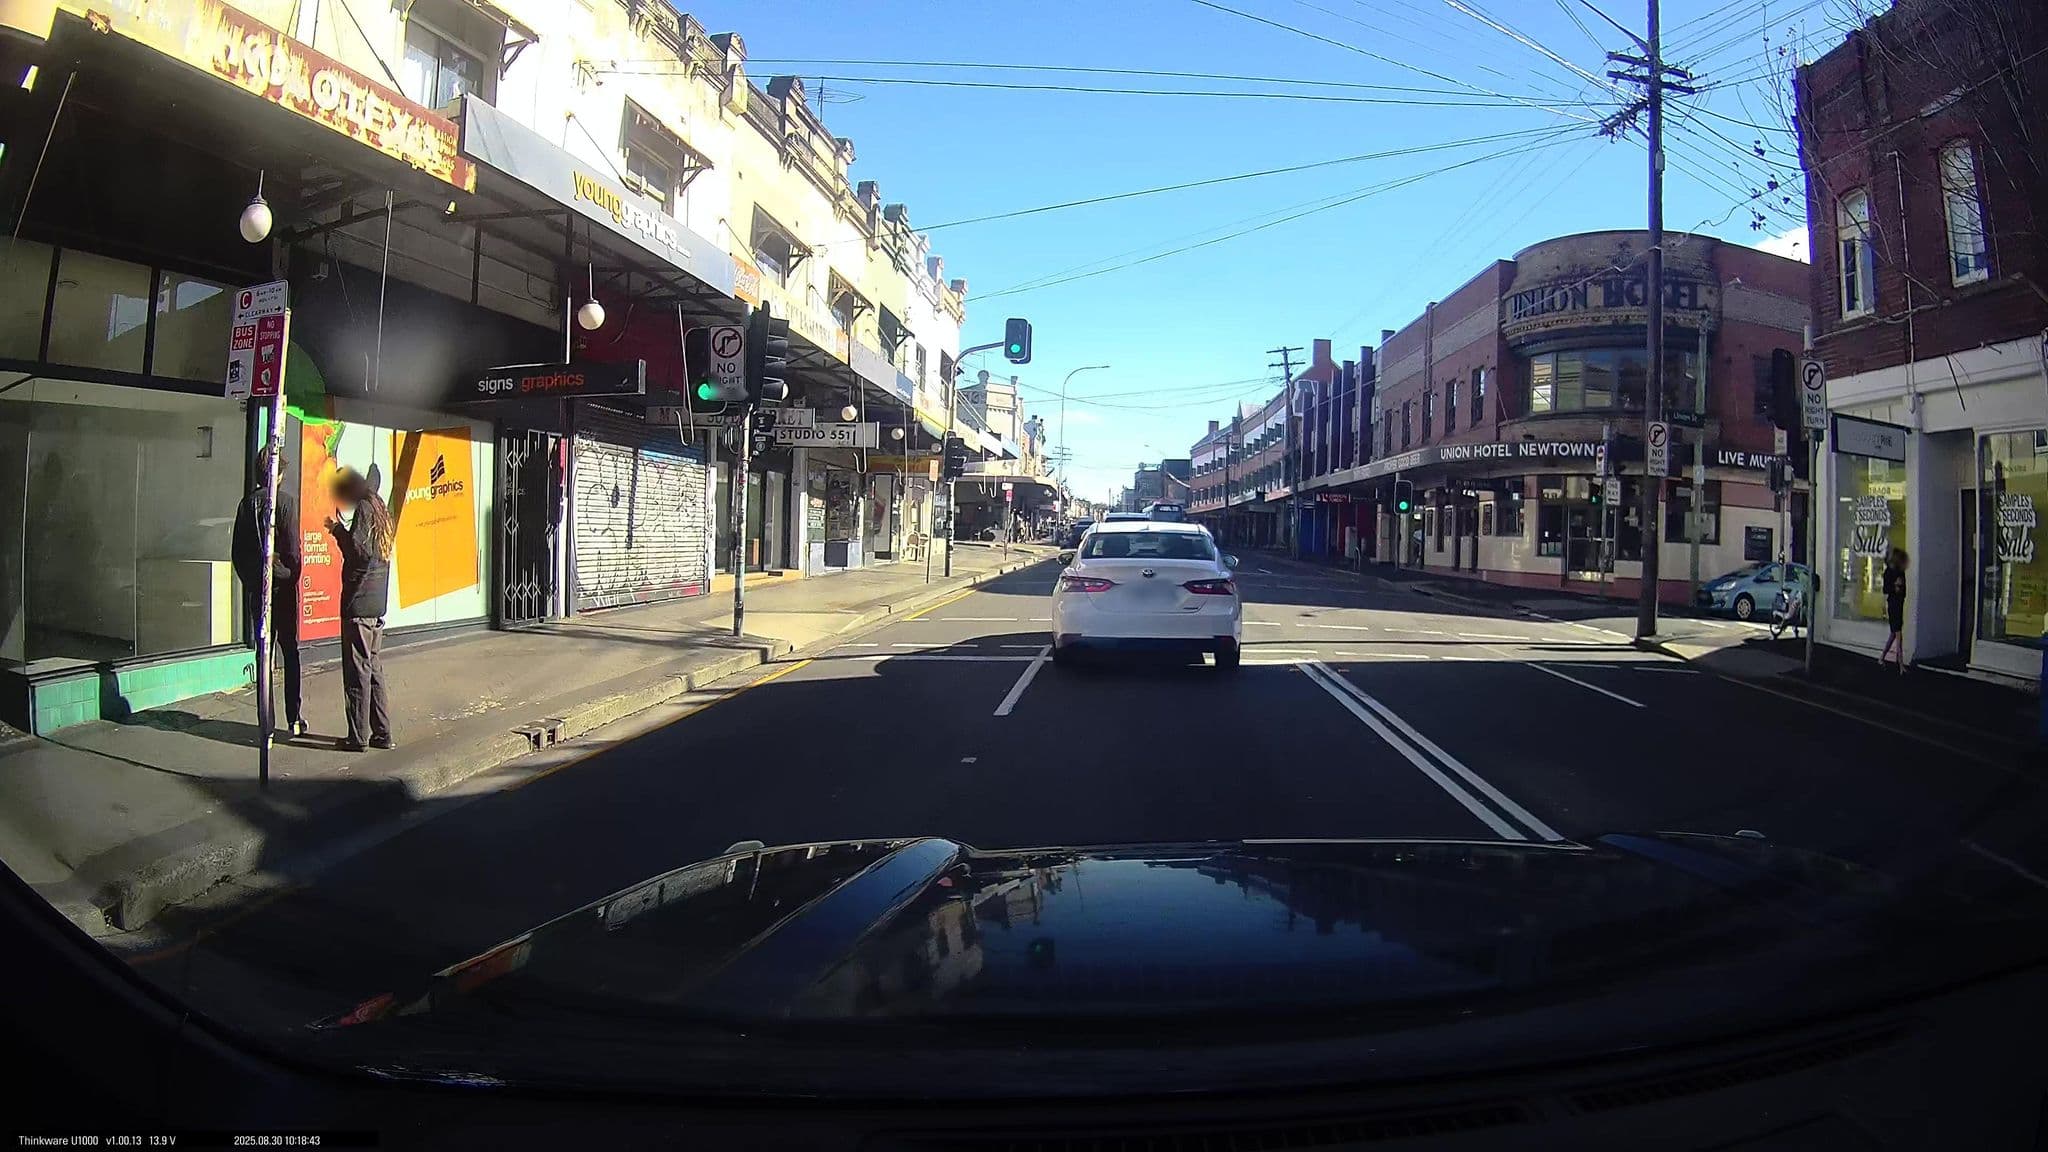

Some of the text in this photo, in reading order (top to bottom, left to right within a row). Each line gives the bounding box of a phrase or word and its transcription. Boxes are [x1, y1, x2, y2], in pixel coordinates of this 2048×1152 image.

[241, 291, 250, 308] C
[1513, 278, 1706, 318] UNION HOEL
[244, 308, 274, 318] CLEARWAY
[266, 320, 275, 329] NO
[235, 326, 254, 337] BUS
[259, 330, 281, 341] STOPPING
[233, 338, 254, 350] ZONE
[716, 362, 736, 374] NO
[478, 372, 585, 395] signs graphics
[1807, 394, 1821, 404] NO
[1805, 406, 1825, 415] RIGHT
[1806, 416, 1825, 426] TURN
[780, 429, 851, 440] STUDIO 551
[1439, 442, 1595, 460] UNION HOTEL NEWTOWN
[1651, 449, 1664, 458] NO
[1718, 450, 1745, 466] LIVE
[405, 480, 464, 503] younggraphics
[1856, 496, 1885, 508] SAMPLES
[1999, 493, 2031, 507] SAMPLES
[1859, 509, 1888, 522] SECONDS
[2003, 509, 2033, 523] SECONDS
[303, 529, 322, 543] large
[1853, 524, 1885, 554] Sale
[1997, 525, 2031, 558] Sale
[303, 541, 328, 553] format
[303, 553, 331, 566] printing
